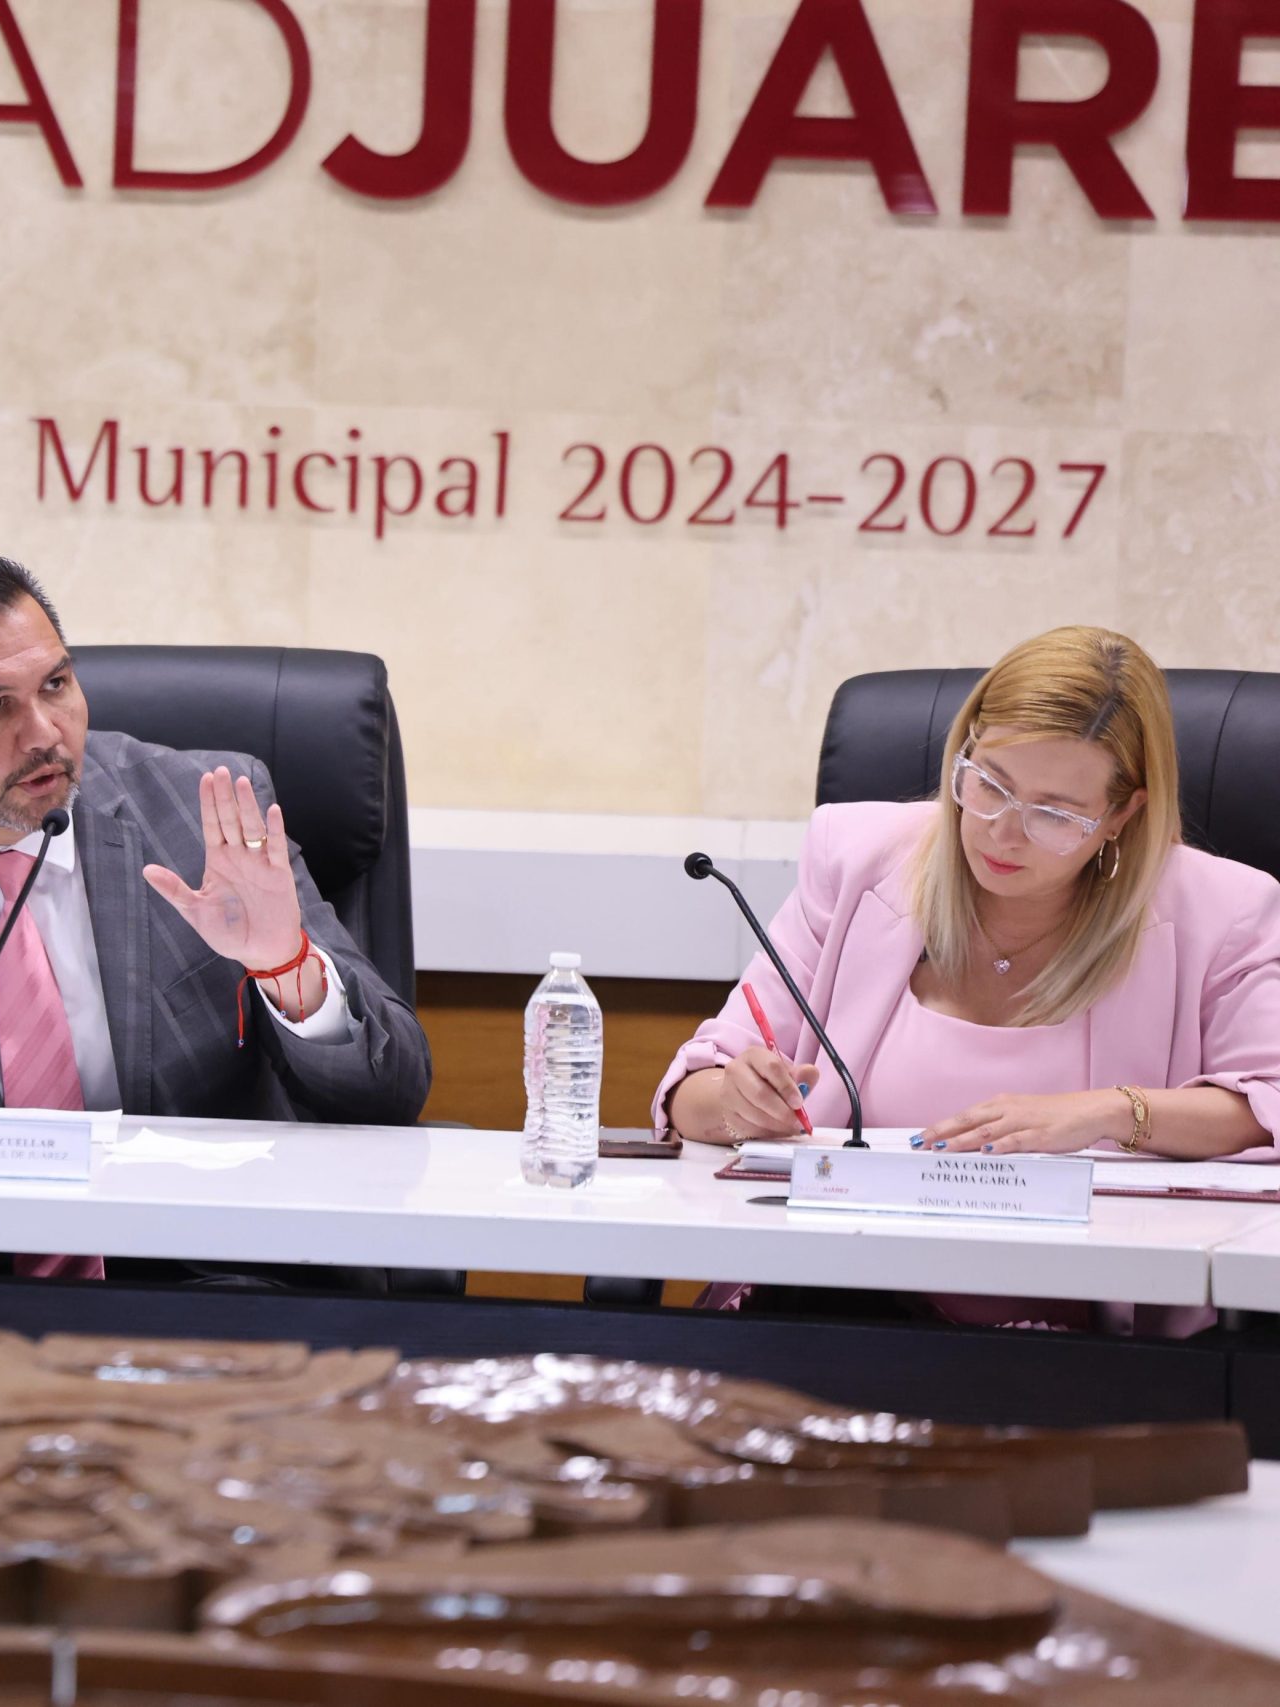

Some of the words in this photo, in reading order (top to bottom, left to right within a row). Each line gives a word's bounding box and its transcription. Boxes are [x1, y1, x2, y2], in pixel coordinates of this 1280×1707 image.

[30, 417, 511, 540] Municipal
[10, 1149, 25, 1160] DE
[935, 1160, 959, 1170] ANA
[962, 1161, 1016, 1172] CARMEN
[921, 1172, 976, 1184] ESTRADA
[979, 1175, 1027, 1187] GARCÍA
[917, 1195, 961, 1207] SÍNDICA
[964, 1199, 1025, 1212] MUNICIPAL
